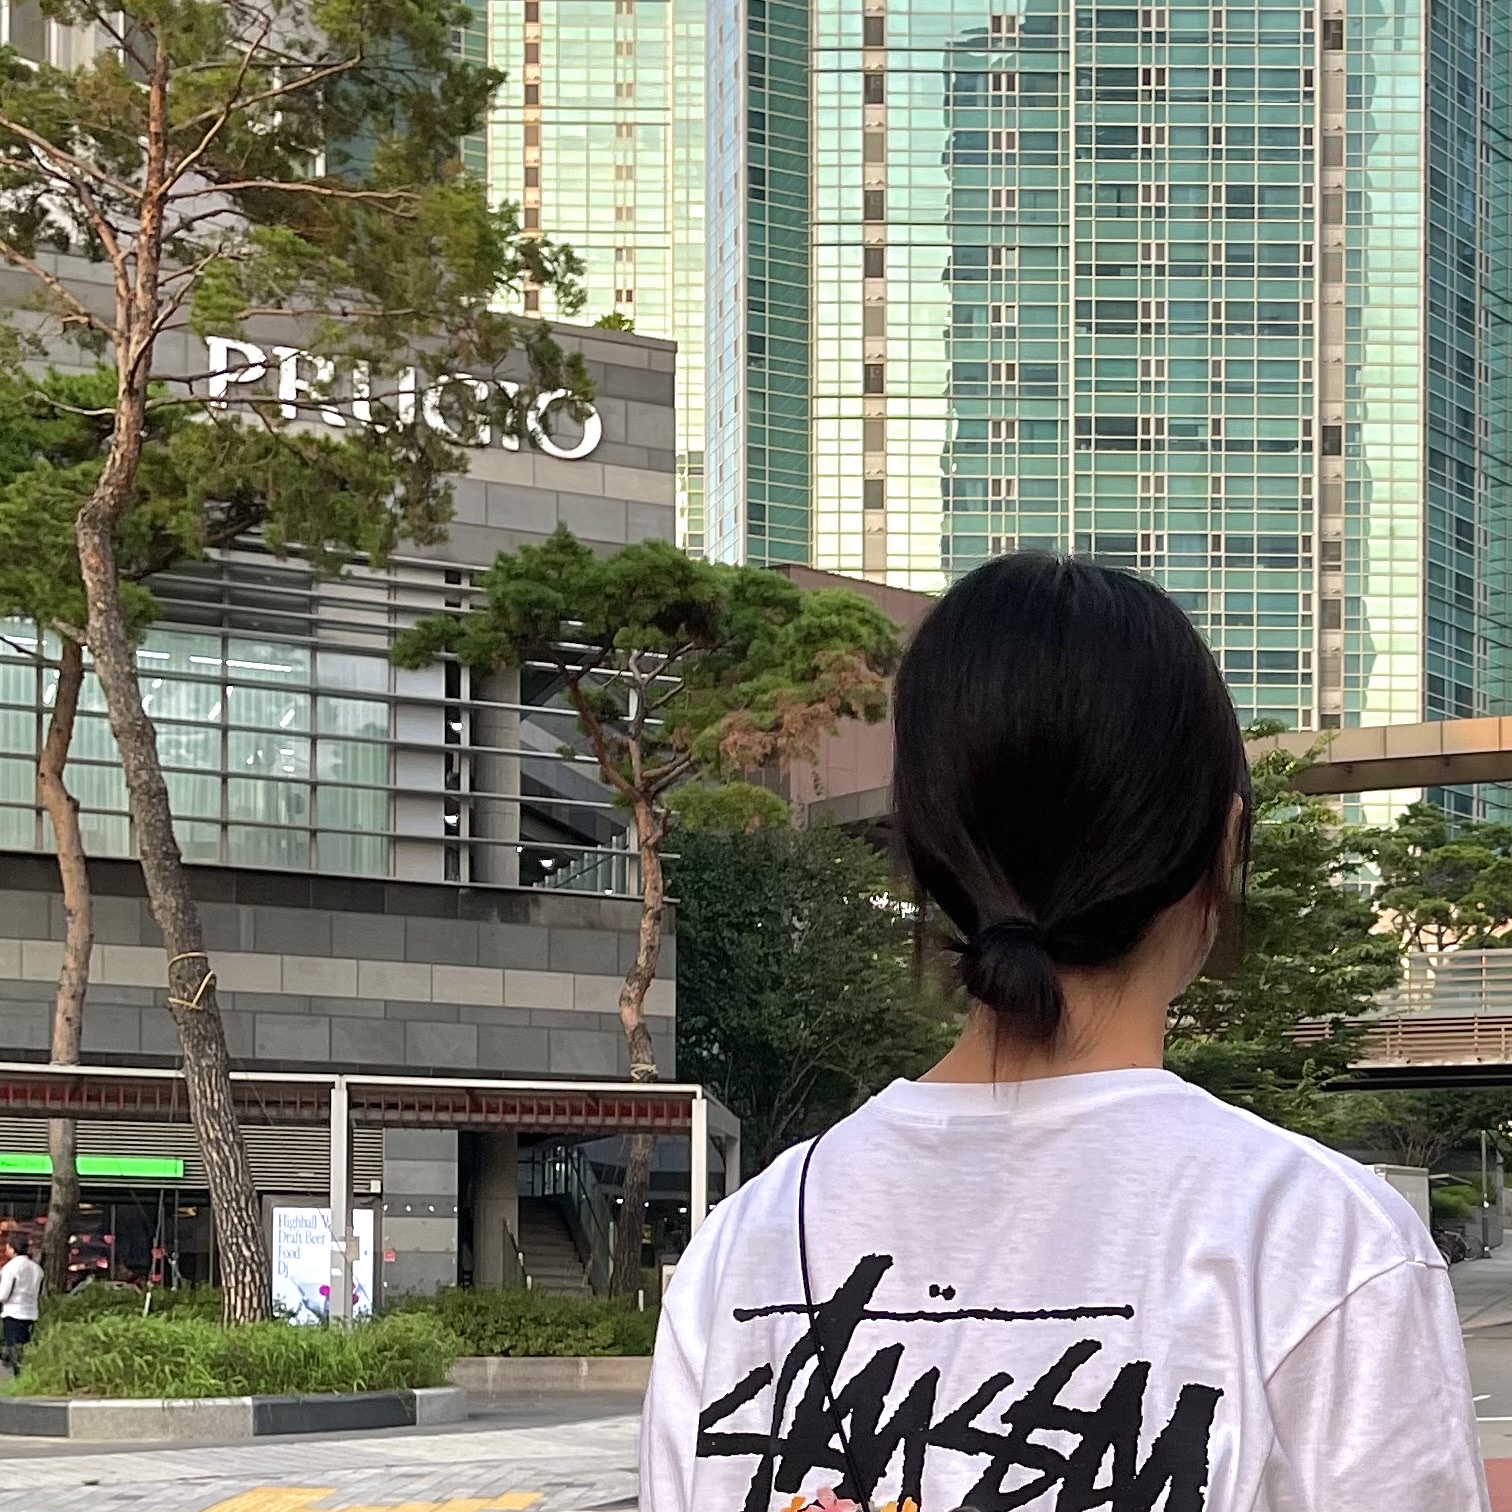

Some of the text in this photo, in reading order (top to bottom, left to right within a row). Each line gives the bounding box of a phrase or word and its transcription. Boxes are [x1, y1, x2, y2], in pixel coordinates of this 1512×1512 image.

[278, 1213, 317, 1230] Highball
[278, 1229, 326, 1245] Draft Beer
[278, 1244, 301, 1260] Food
